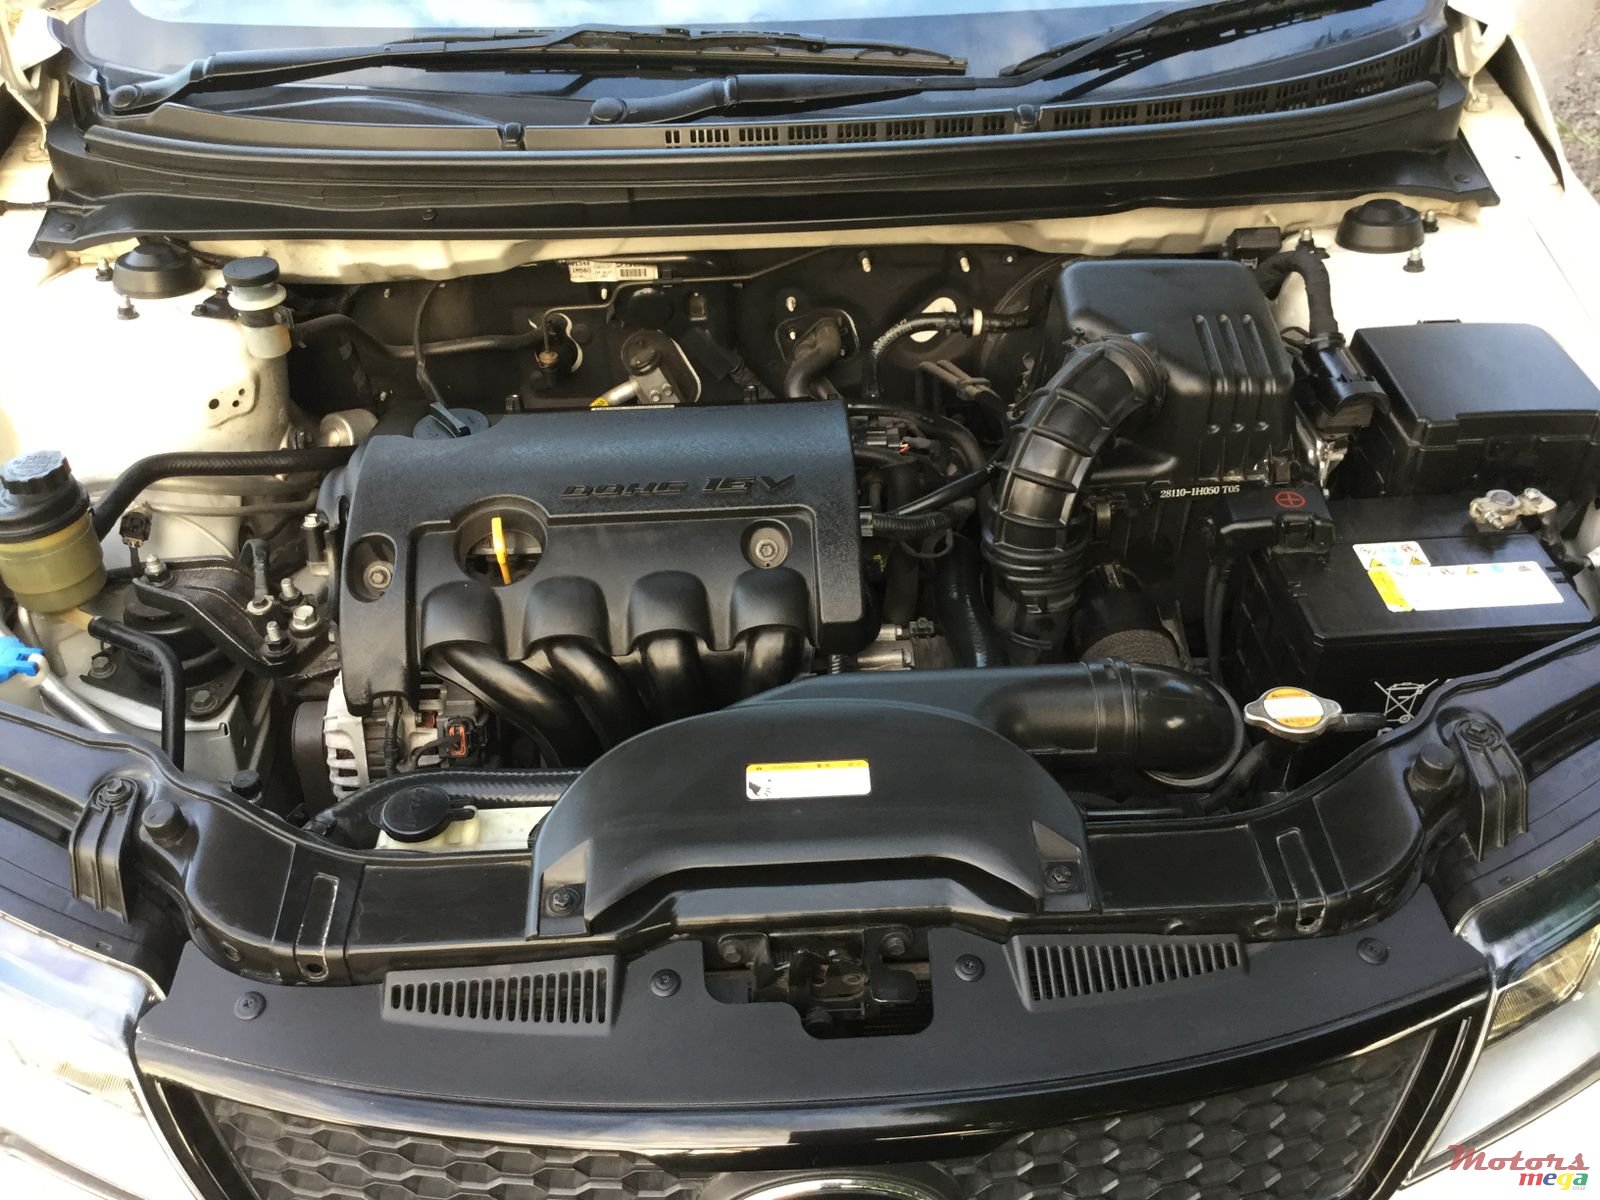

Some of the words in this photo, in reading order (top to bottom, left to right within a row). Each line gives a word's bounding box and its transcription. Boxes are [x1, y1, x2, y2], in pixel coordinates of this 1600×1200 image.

[560, 481, 690, 498] DOHC
[702, 474, 796, 493] 16V
[1160, 485, 1220, 498] 28110-1H050
[1222, 484, 1240, 494] T05
